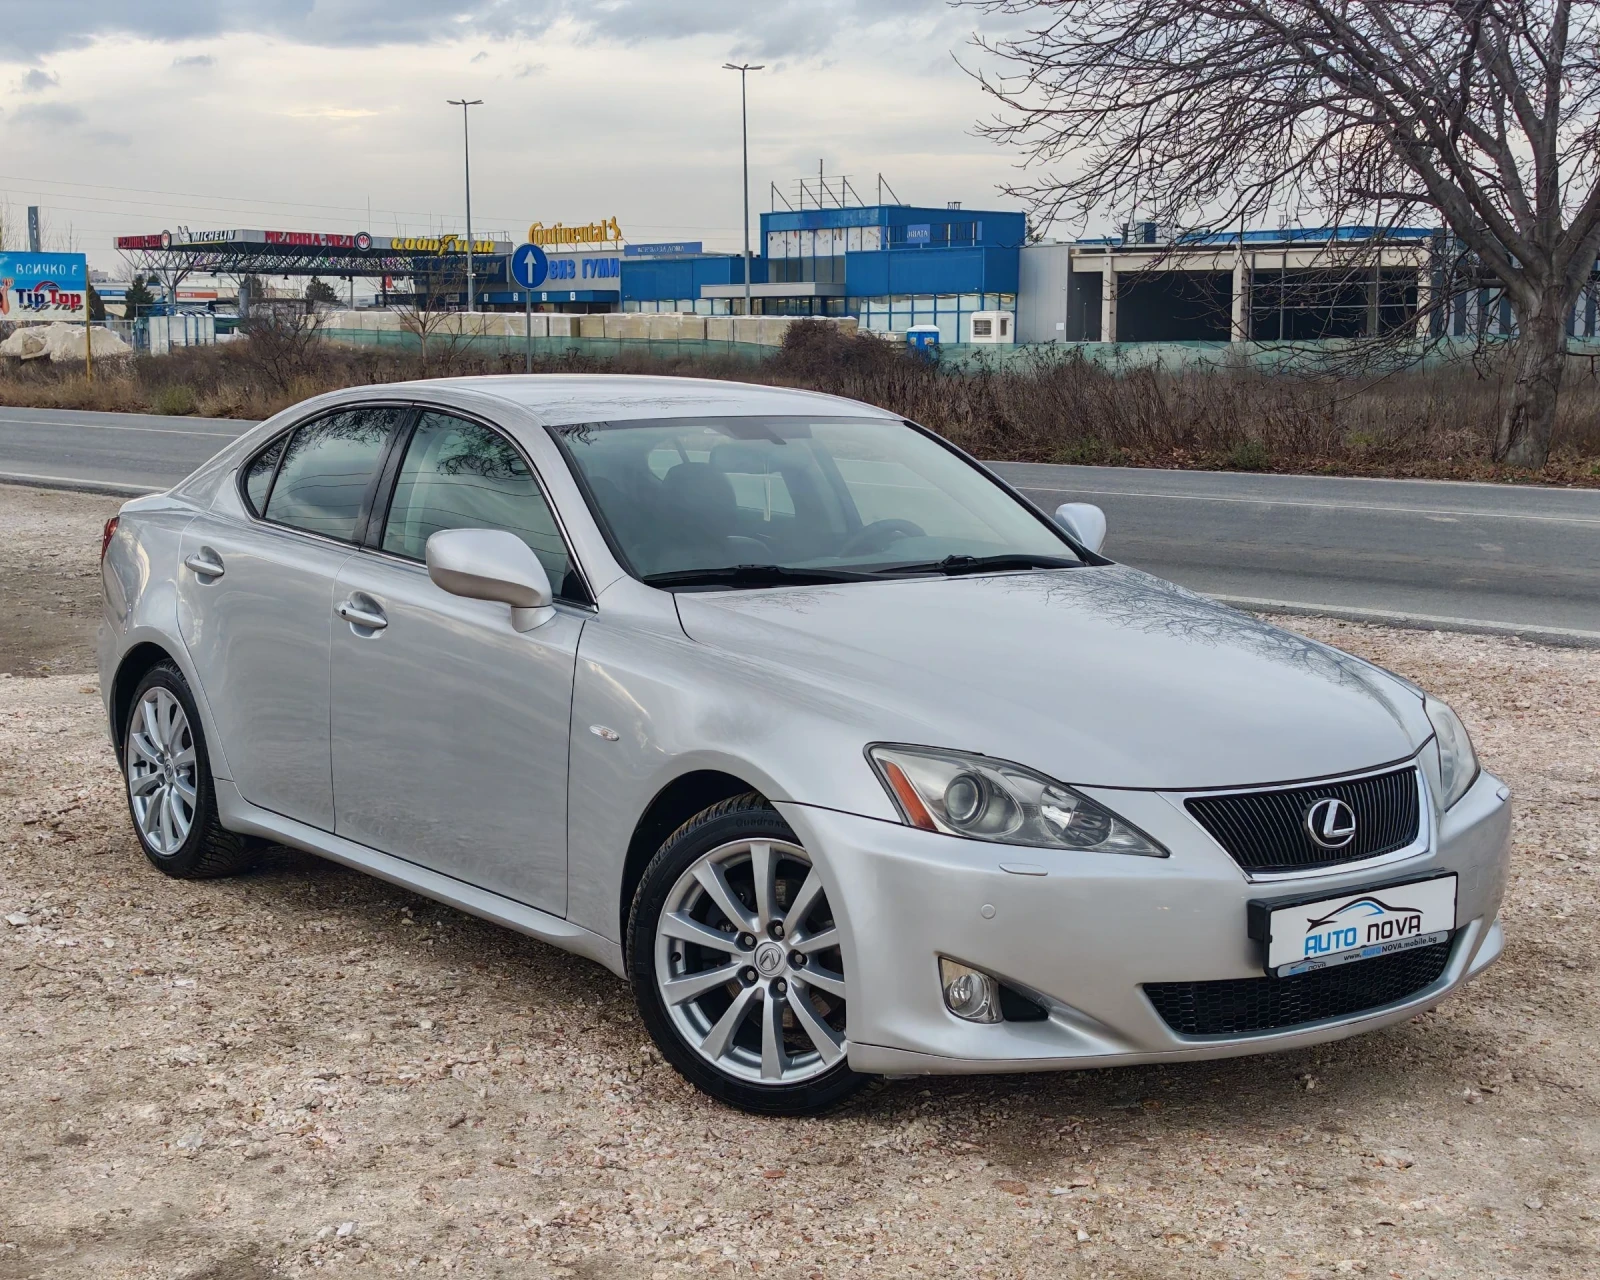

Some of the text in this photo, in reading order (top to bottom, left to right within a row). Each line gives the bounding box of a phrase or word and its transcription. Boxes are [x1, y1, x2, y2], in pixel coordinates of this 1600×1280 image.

[191, 230, 236, 243] MICHELIN
[528, 220, 607, 248] Continental
[16, 263, 66, 275] ВСИЧКО
[582, 258, 620, 279] ГУМИ
[15, 289, 81, 309] Tip Top
[1304, 914, 1421, 956] AUTO NOVA
